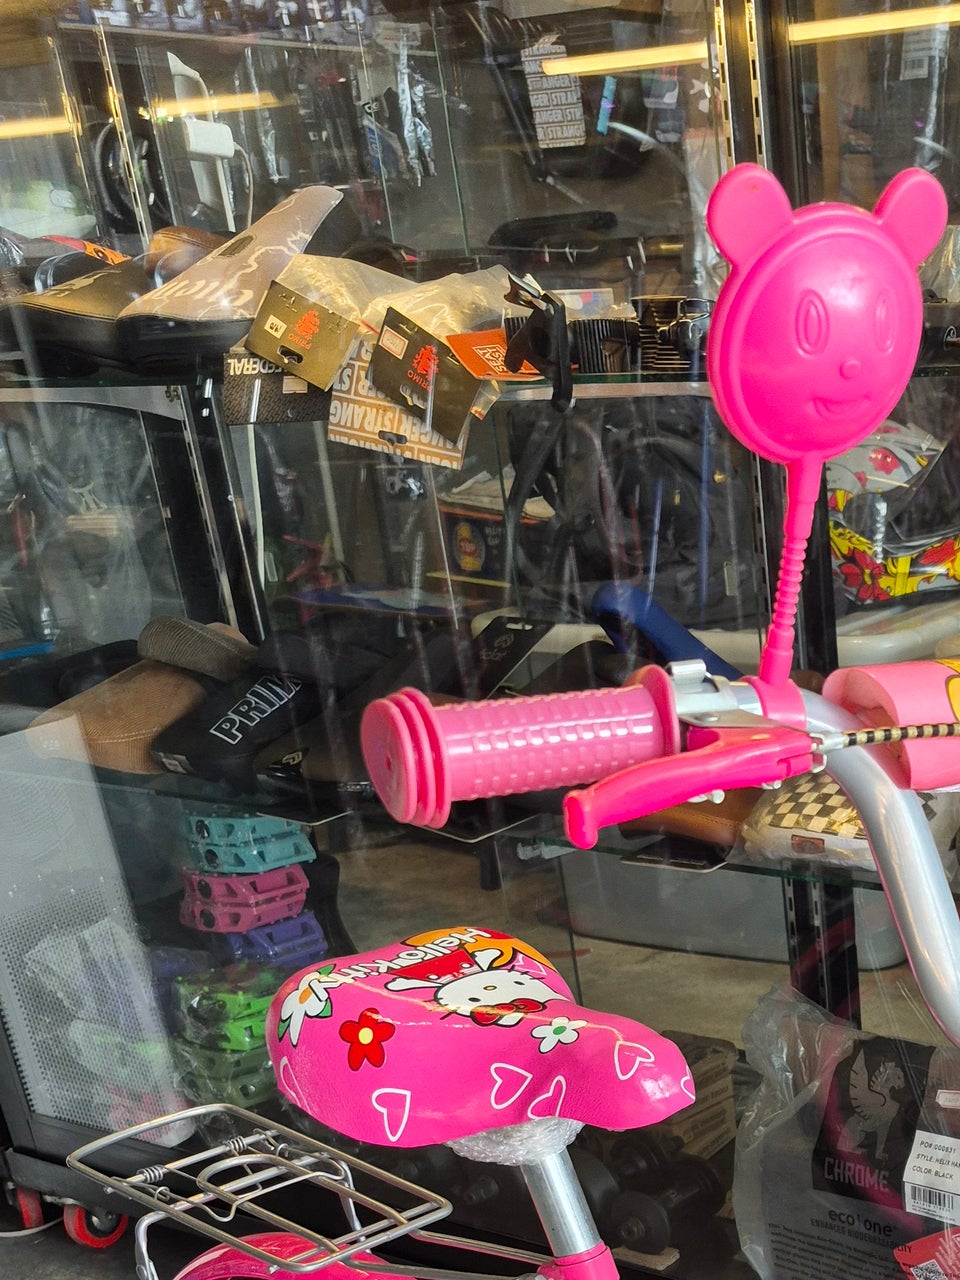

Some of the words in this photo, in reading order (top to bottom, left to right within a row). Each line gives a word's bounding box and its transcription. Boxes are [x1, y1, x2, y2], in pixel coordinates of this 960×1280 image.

[288, 332, 312, 350] PRIMO
[407, 370, 432, 392] PRIMO
[405, 927, 492, 962] Hello
[312, 955, 402, 1001] Kitty
[916, 1153, 933, 1162] STYLE:
[935, 1156, 951, 1166] HELIX
[824, 1157, 889, 1193] CHROME
[912, 1165, 933, 1176] COLOR:
[934, 1169, 954, 1180] BLACK
